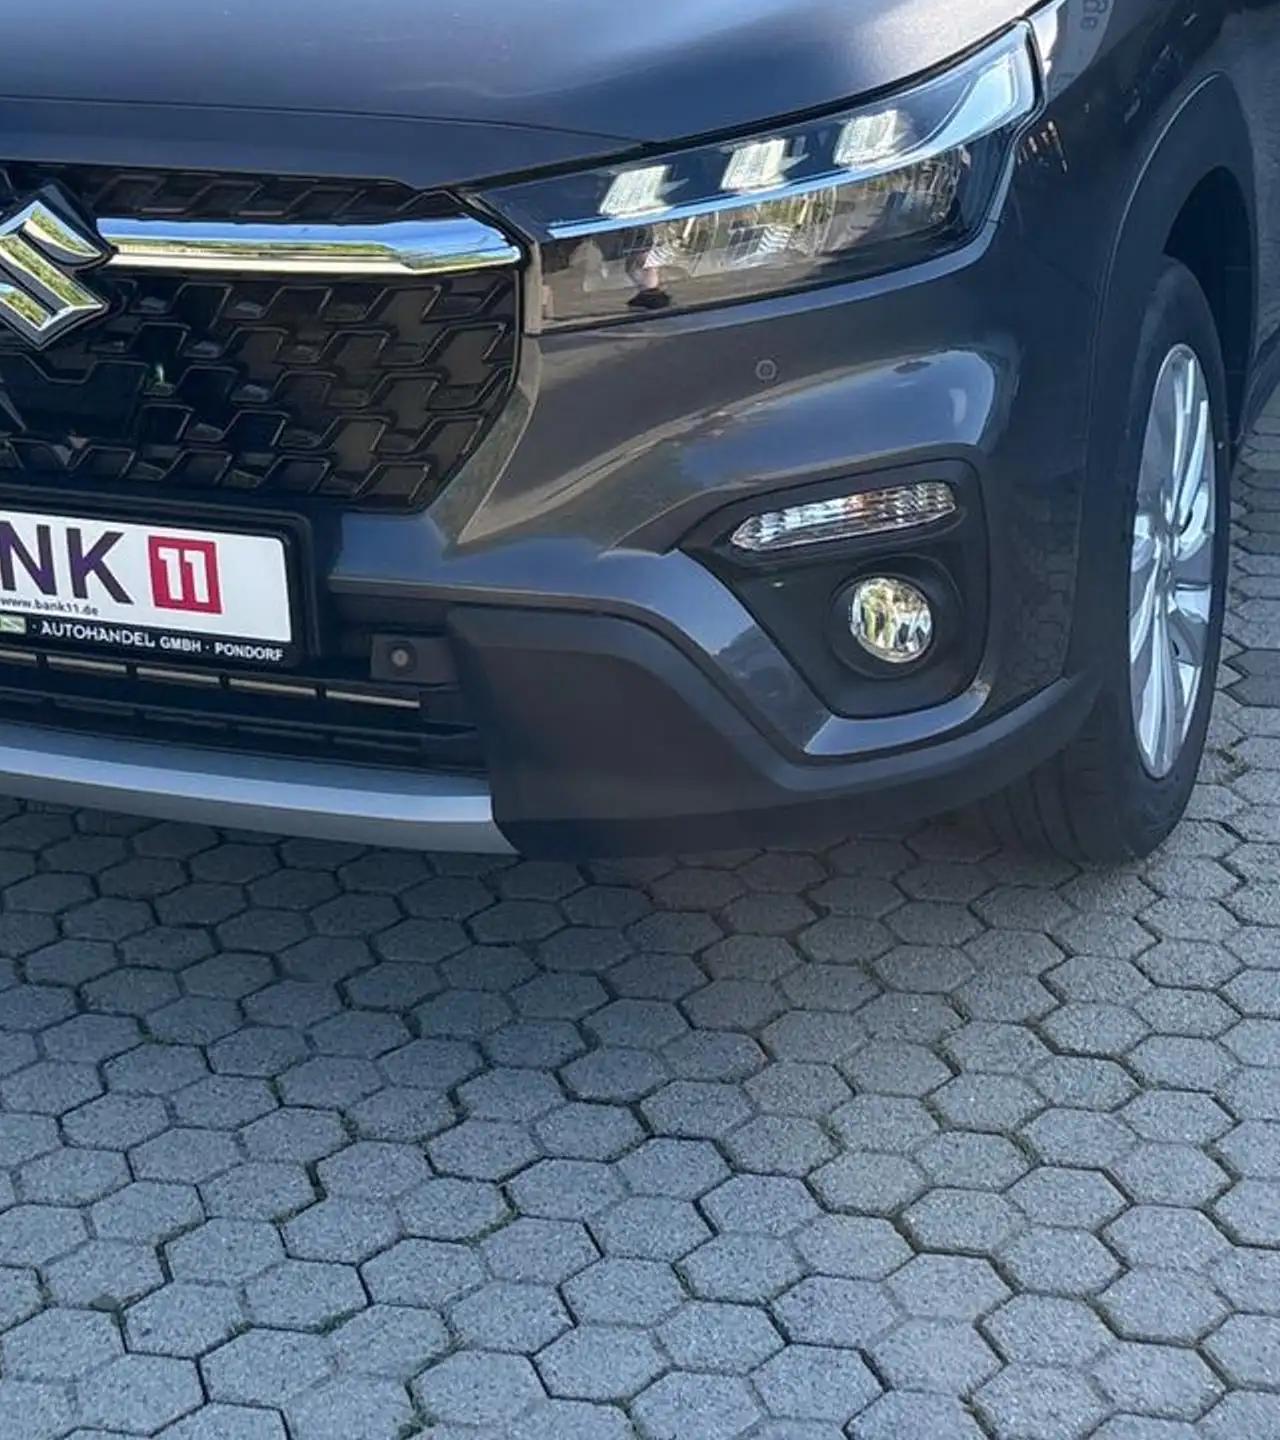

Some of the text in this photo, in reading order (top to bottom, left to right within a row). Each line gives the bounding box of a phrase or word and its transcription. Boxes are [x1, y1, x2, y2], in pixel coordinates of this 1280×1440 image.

[154, 545, 214, 606] 11
[0, 596, 99, 617] www.bank11.de
[41, 619, 155, 648] AUTOHANDEL
[159, 636, 202, 653] GMBH
[214, 642, 283, 662] PONDORF
